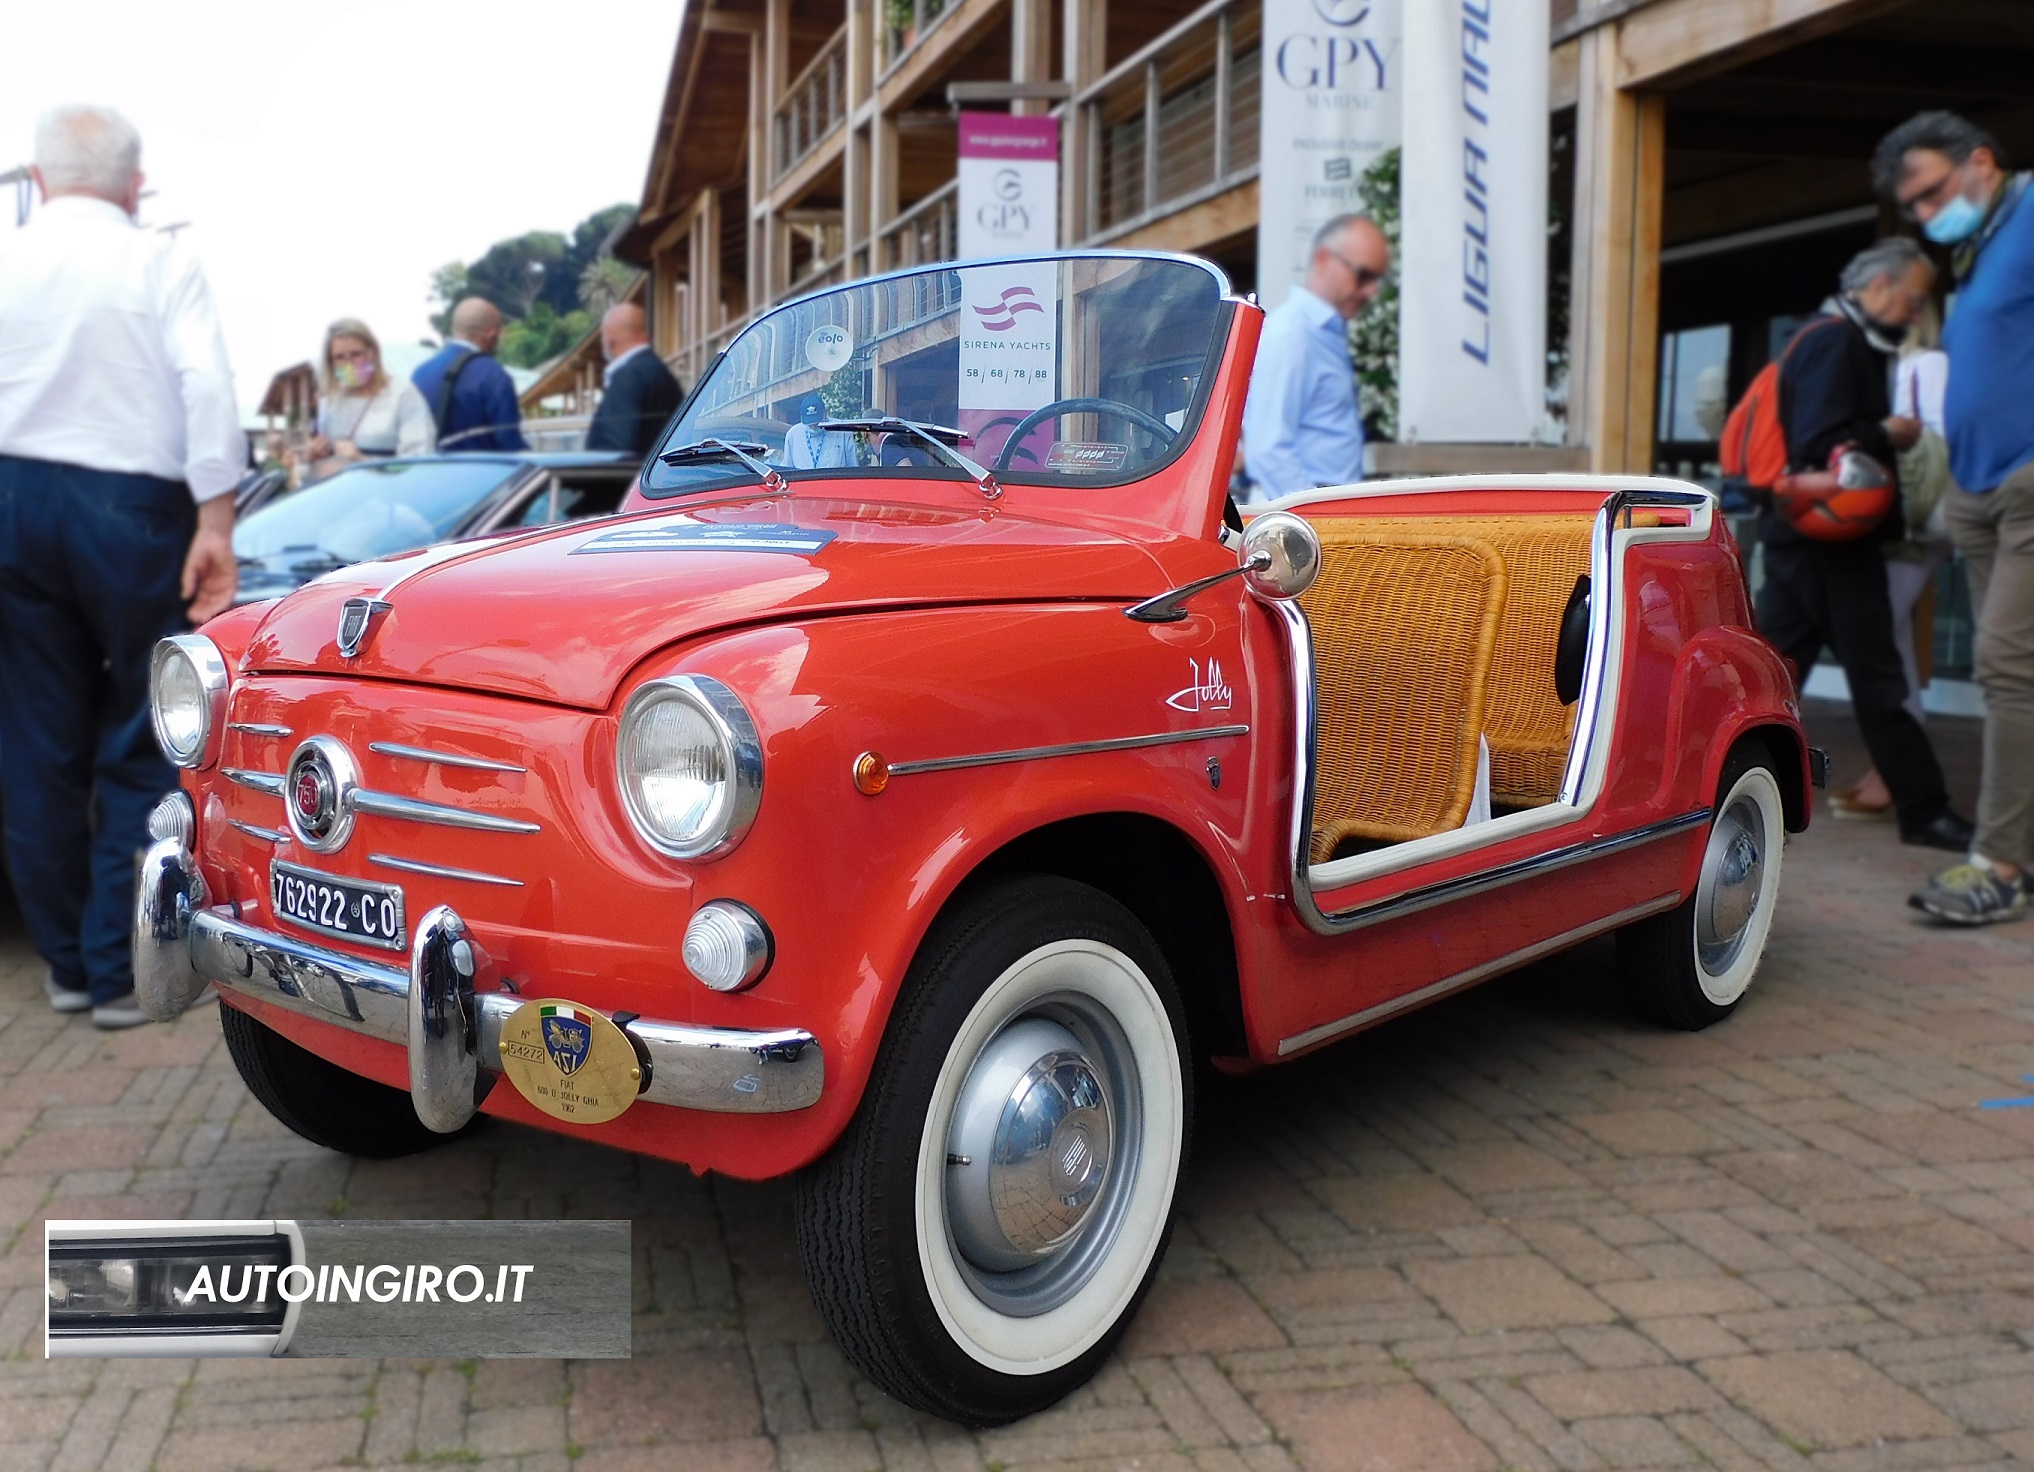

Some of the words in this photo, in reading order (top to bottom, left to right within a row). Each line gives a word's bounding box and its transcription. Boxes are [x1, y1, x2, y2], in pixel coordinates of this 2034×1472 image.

[1276, 33, 1402, 91] GPY
[977, 204, 1037, 231] GPY
[964, 340, 1005, 349] SIRENA
[1009, 341, 1051, 351] YACHTS
[966, 368, 979, 378] 58
[990, 369, 1003, 378] 68
[1013, 369, 1026, 379] 78
[1034, 370, 1047, 379] 88
[1165, 657, 1232, 712] Jolly
[275, 873, 348, 931] 762922
[509, 1045, 543, 1061] 54272
[560, 1079, 575, 1090] FIAT
[560, 1091, 580, 1103] JOLLY
[582, 1096, 599, 1107] GHIA
